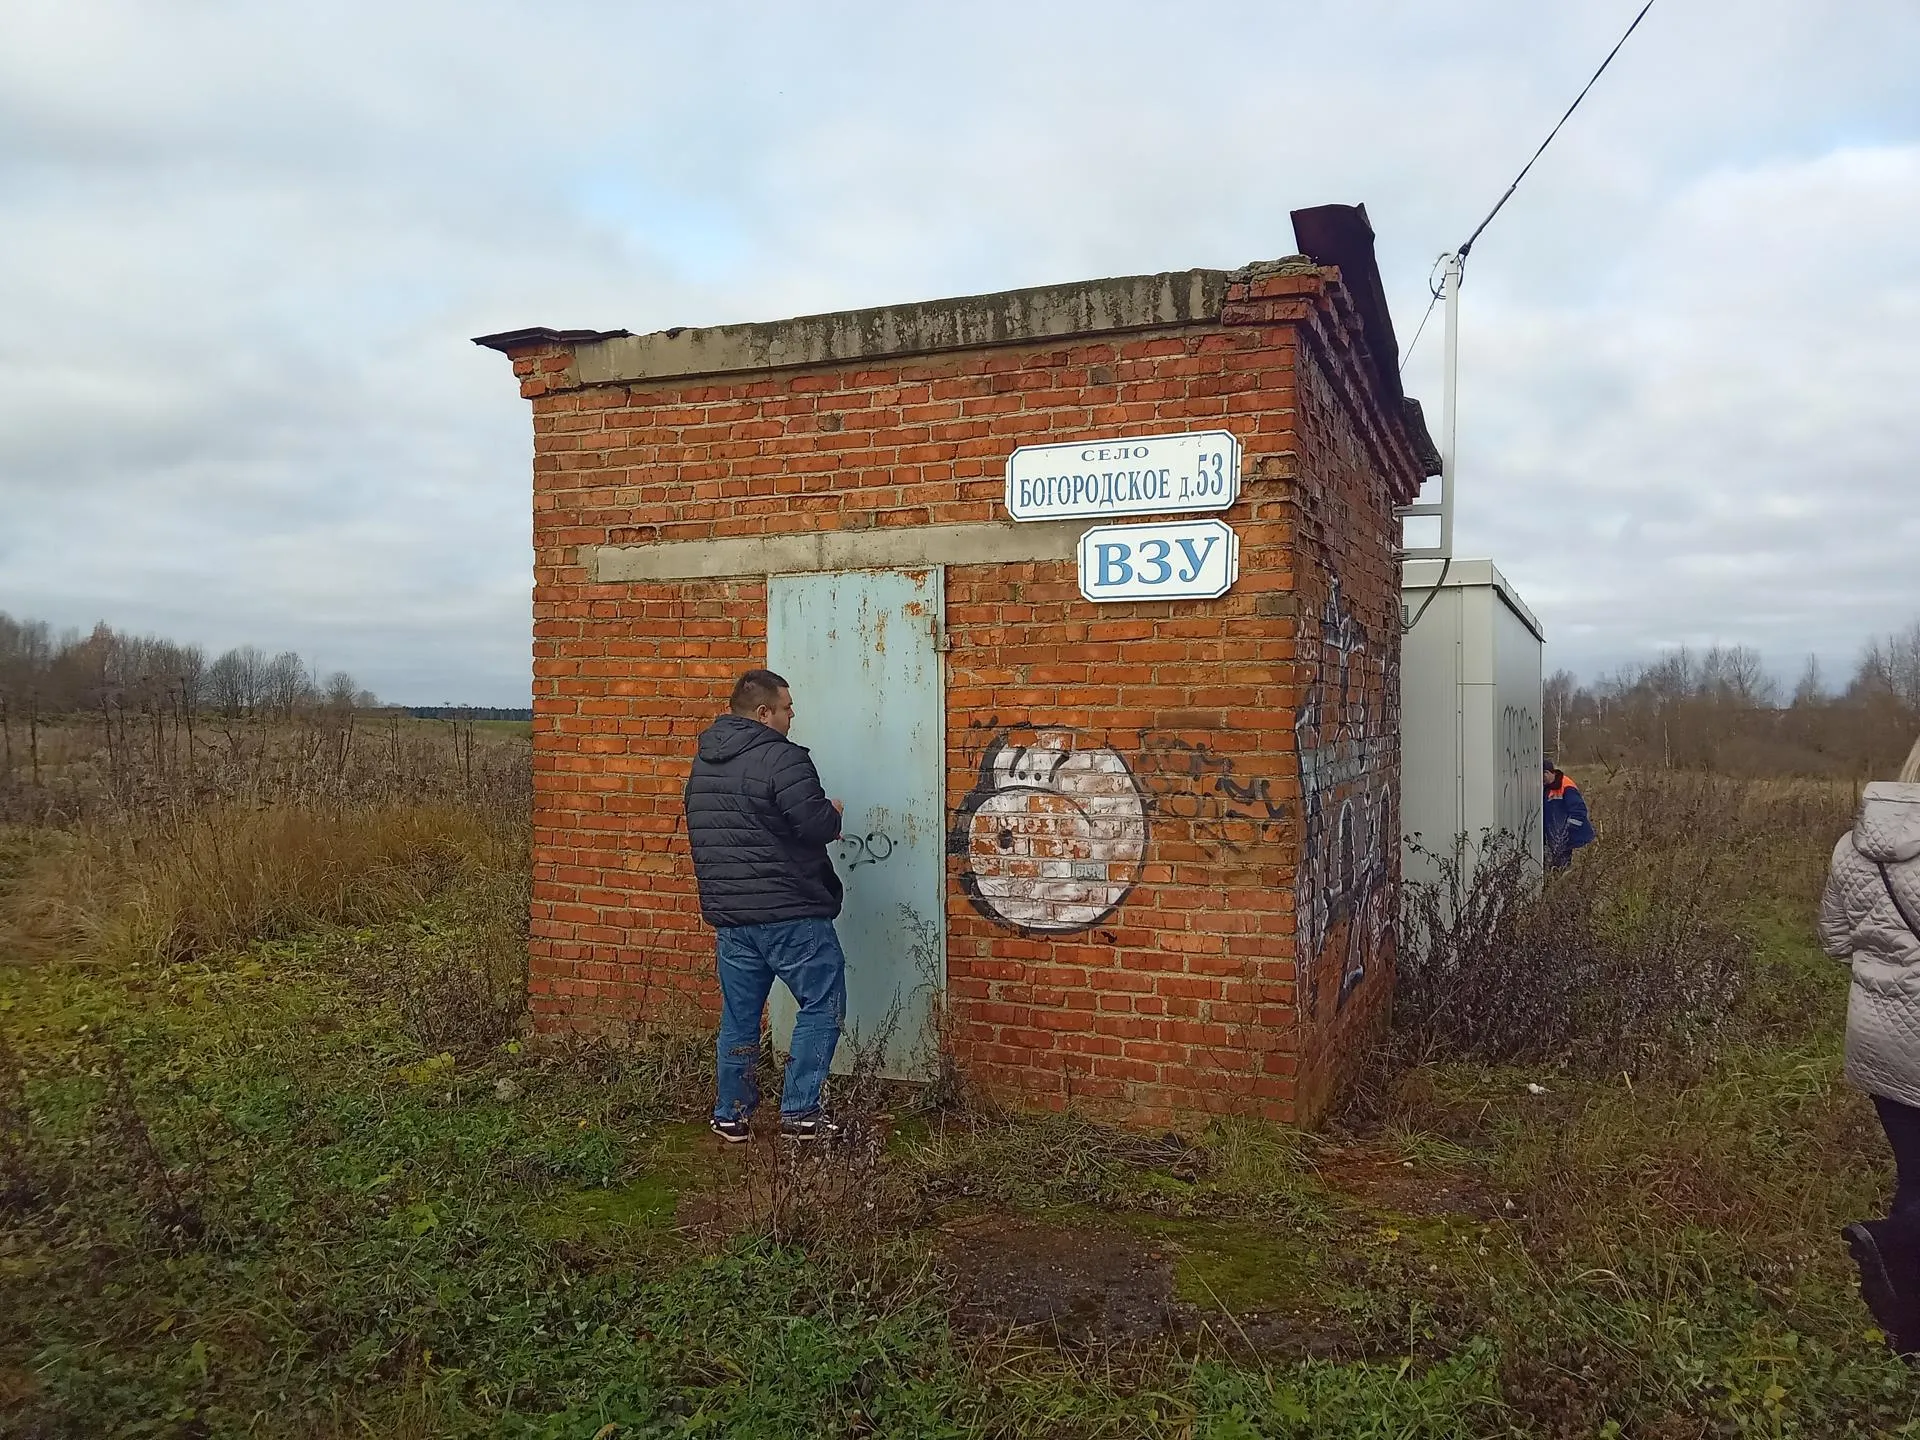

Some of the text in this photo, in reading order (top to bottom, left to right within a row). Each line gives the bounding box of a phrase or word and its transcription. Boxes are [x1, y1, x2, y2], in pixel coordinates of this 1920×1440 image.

[1081, 446, 1149, 462] СЕЛО
[1019, 468, 1170, 508] БОГОРОДСКОЕ
[1094, 536, 1219, 587] ВЗУ
